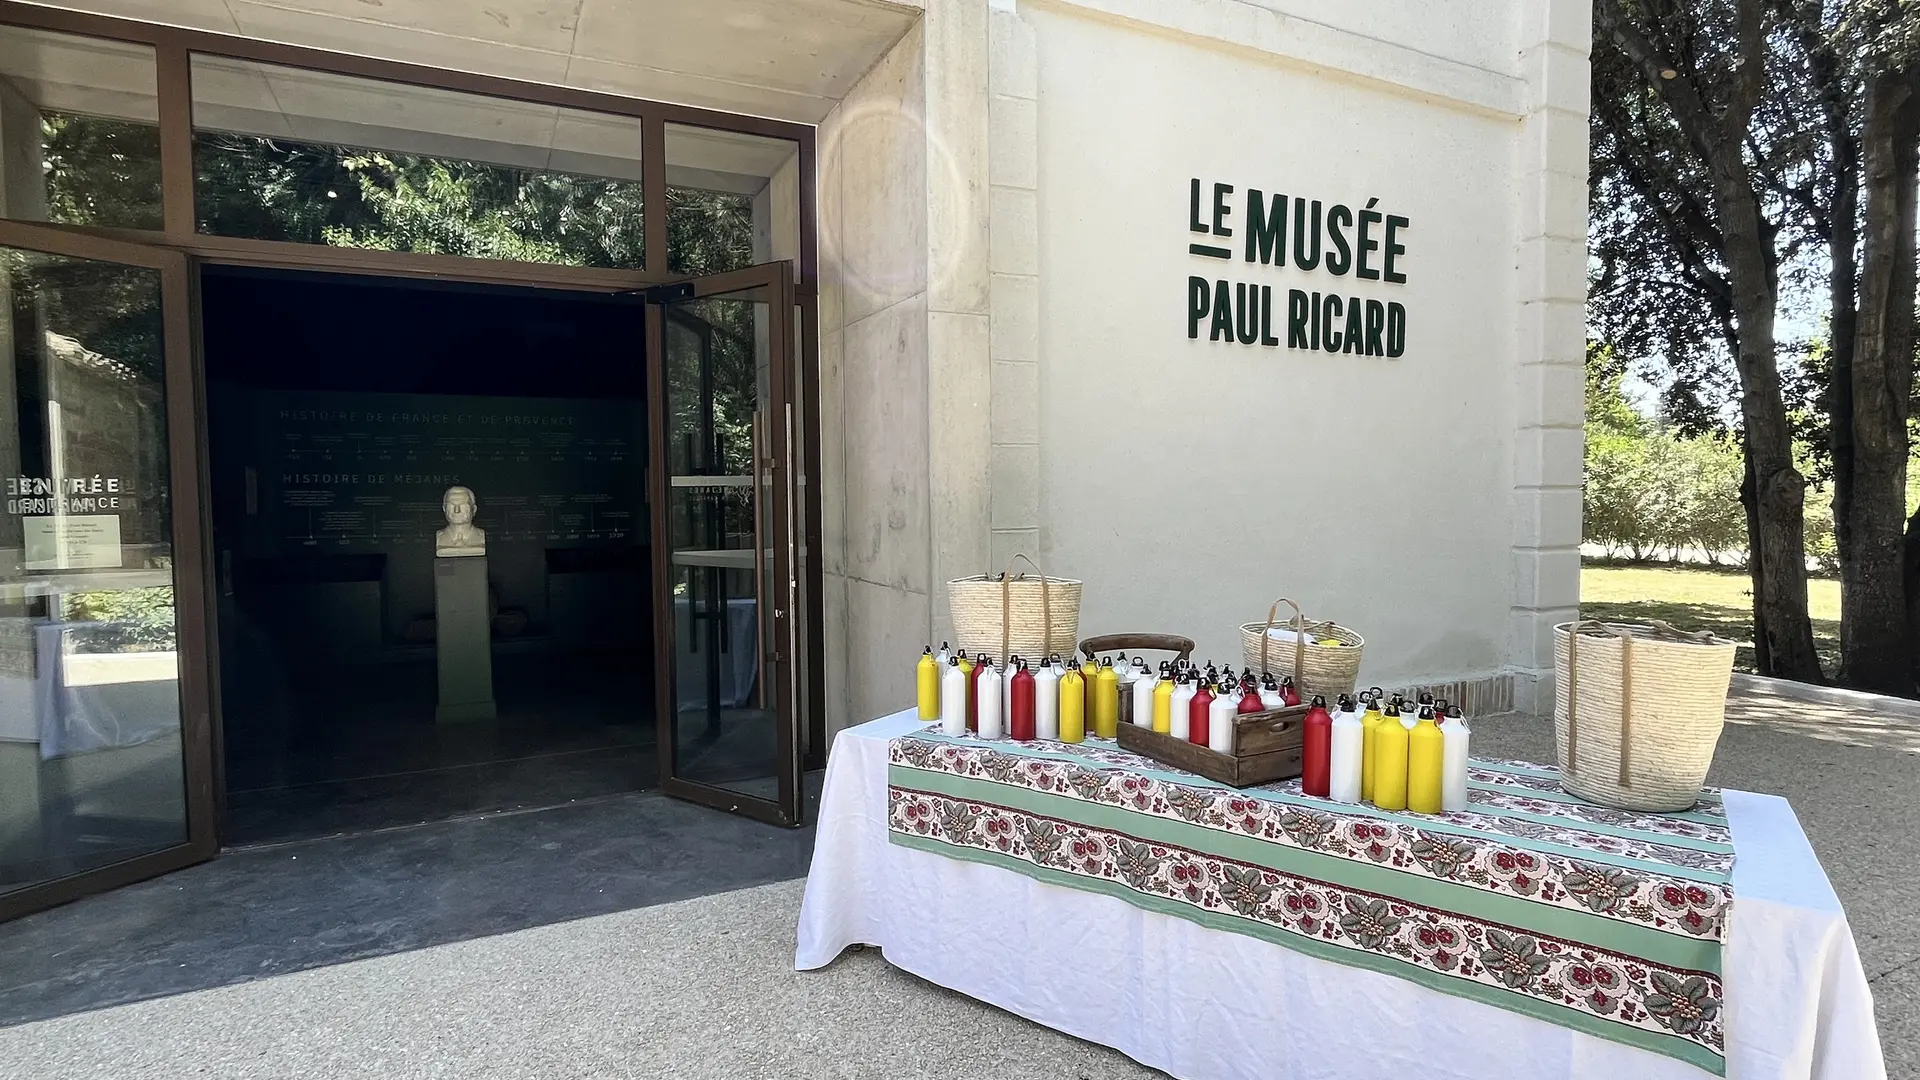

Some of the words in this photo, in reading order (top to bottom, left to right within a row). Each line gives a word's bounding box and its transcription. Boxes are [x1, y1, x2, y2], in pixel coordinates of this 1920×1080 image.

[1189, 178, 1234, 237] LE
[1245, 189, 1410, 284] MUSÉE
[1188, 275, 1279, 346] PAUL
[1287, 288, 1407, 358] RICARD
[280, 410, 357, 422] HISTOIRE
[366, 412, 384, 423] DE
[392, 412, 449, 424] FRANCE
[457, 413, 473, 424] ET
[481, 414, 498, 425] DE
[505, 415, 576, 426] PROVENCE
[282, 474, 360, 484] HISTOIRE
[367, 474, 385, 484] DE
